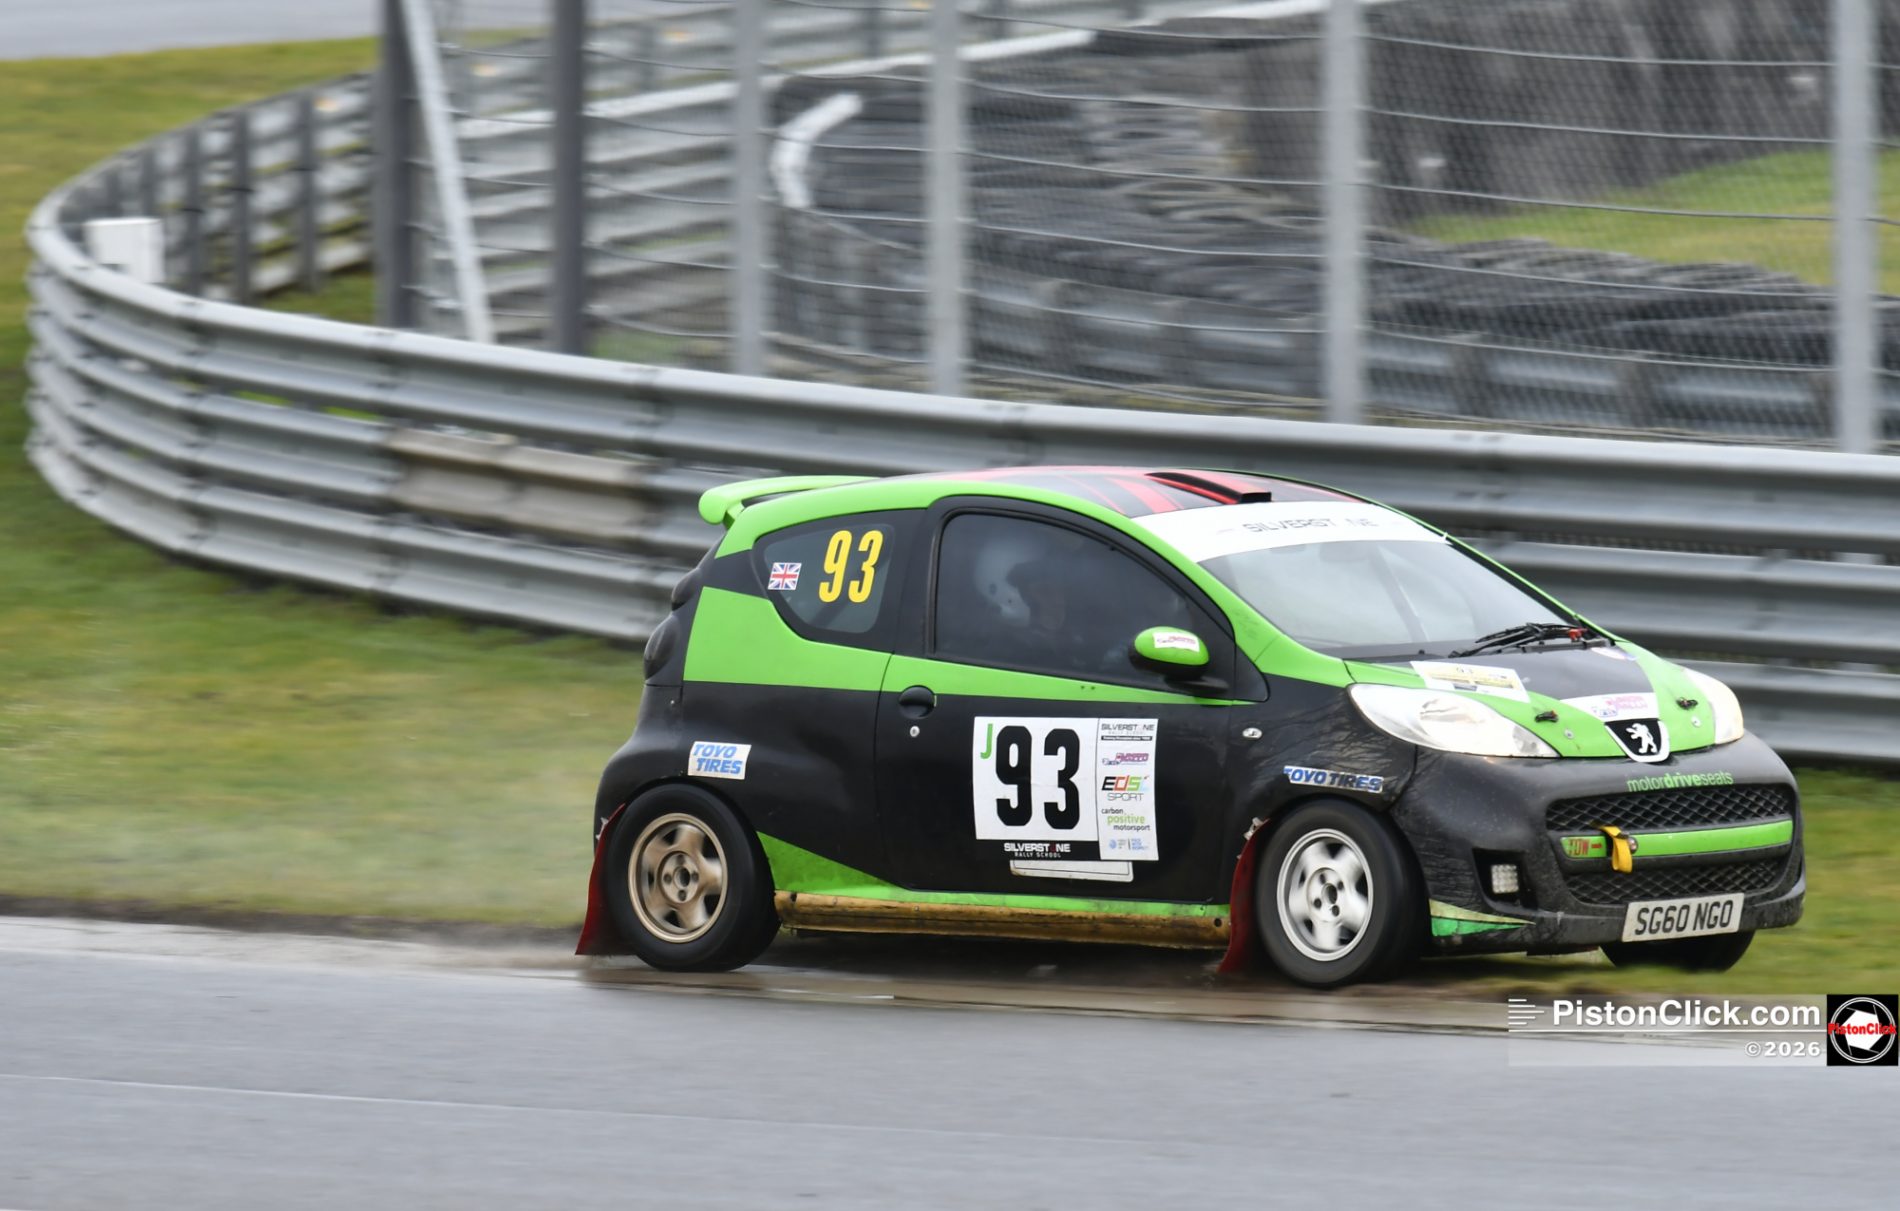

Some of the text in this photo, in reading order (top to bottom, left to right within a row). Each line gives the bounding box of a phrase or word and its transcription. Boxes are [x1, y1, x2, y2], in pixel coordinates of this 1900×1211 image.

[819, 530, 883, 603] 93
[693, 744, 737, 758] TOYO
[696, 758, 743, 775] TIRES
[980, 724, 1080, 830] J 93
[1329, 772, 1383, 791] TIRES
[1107, 793, 1144, 801] SPORT
[1107, 813, 1145, 825] positive
[1113, 824, 1151, 832] motorsport
[1635, 900, 1734, 936] SG60 NGO
